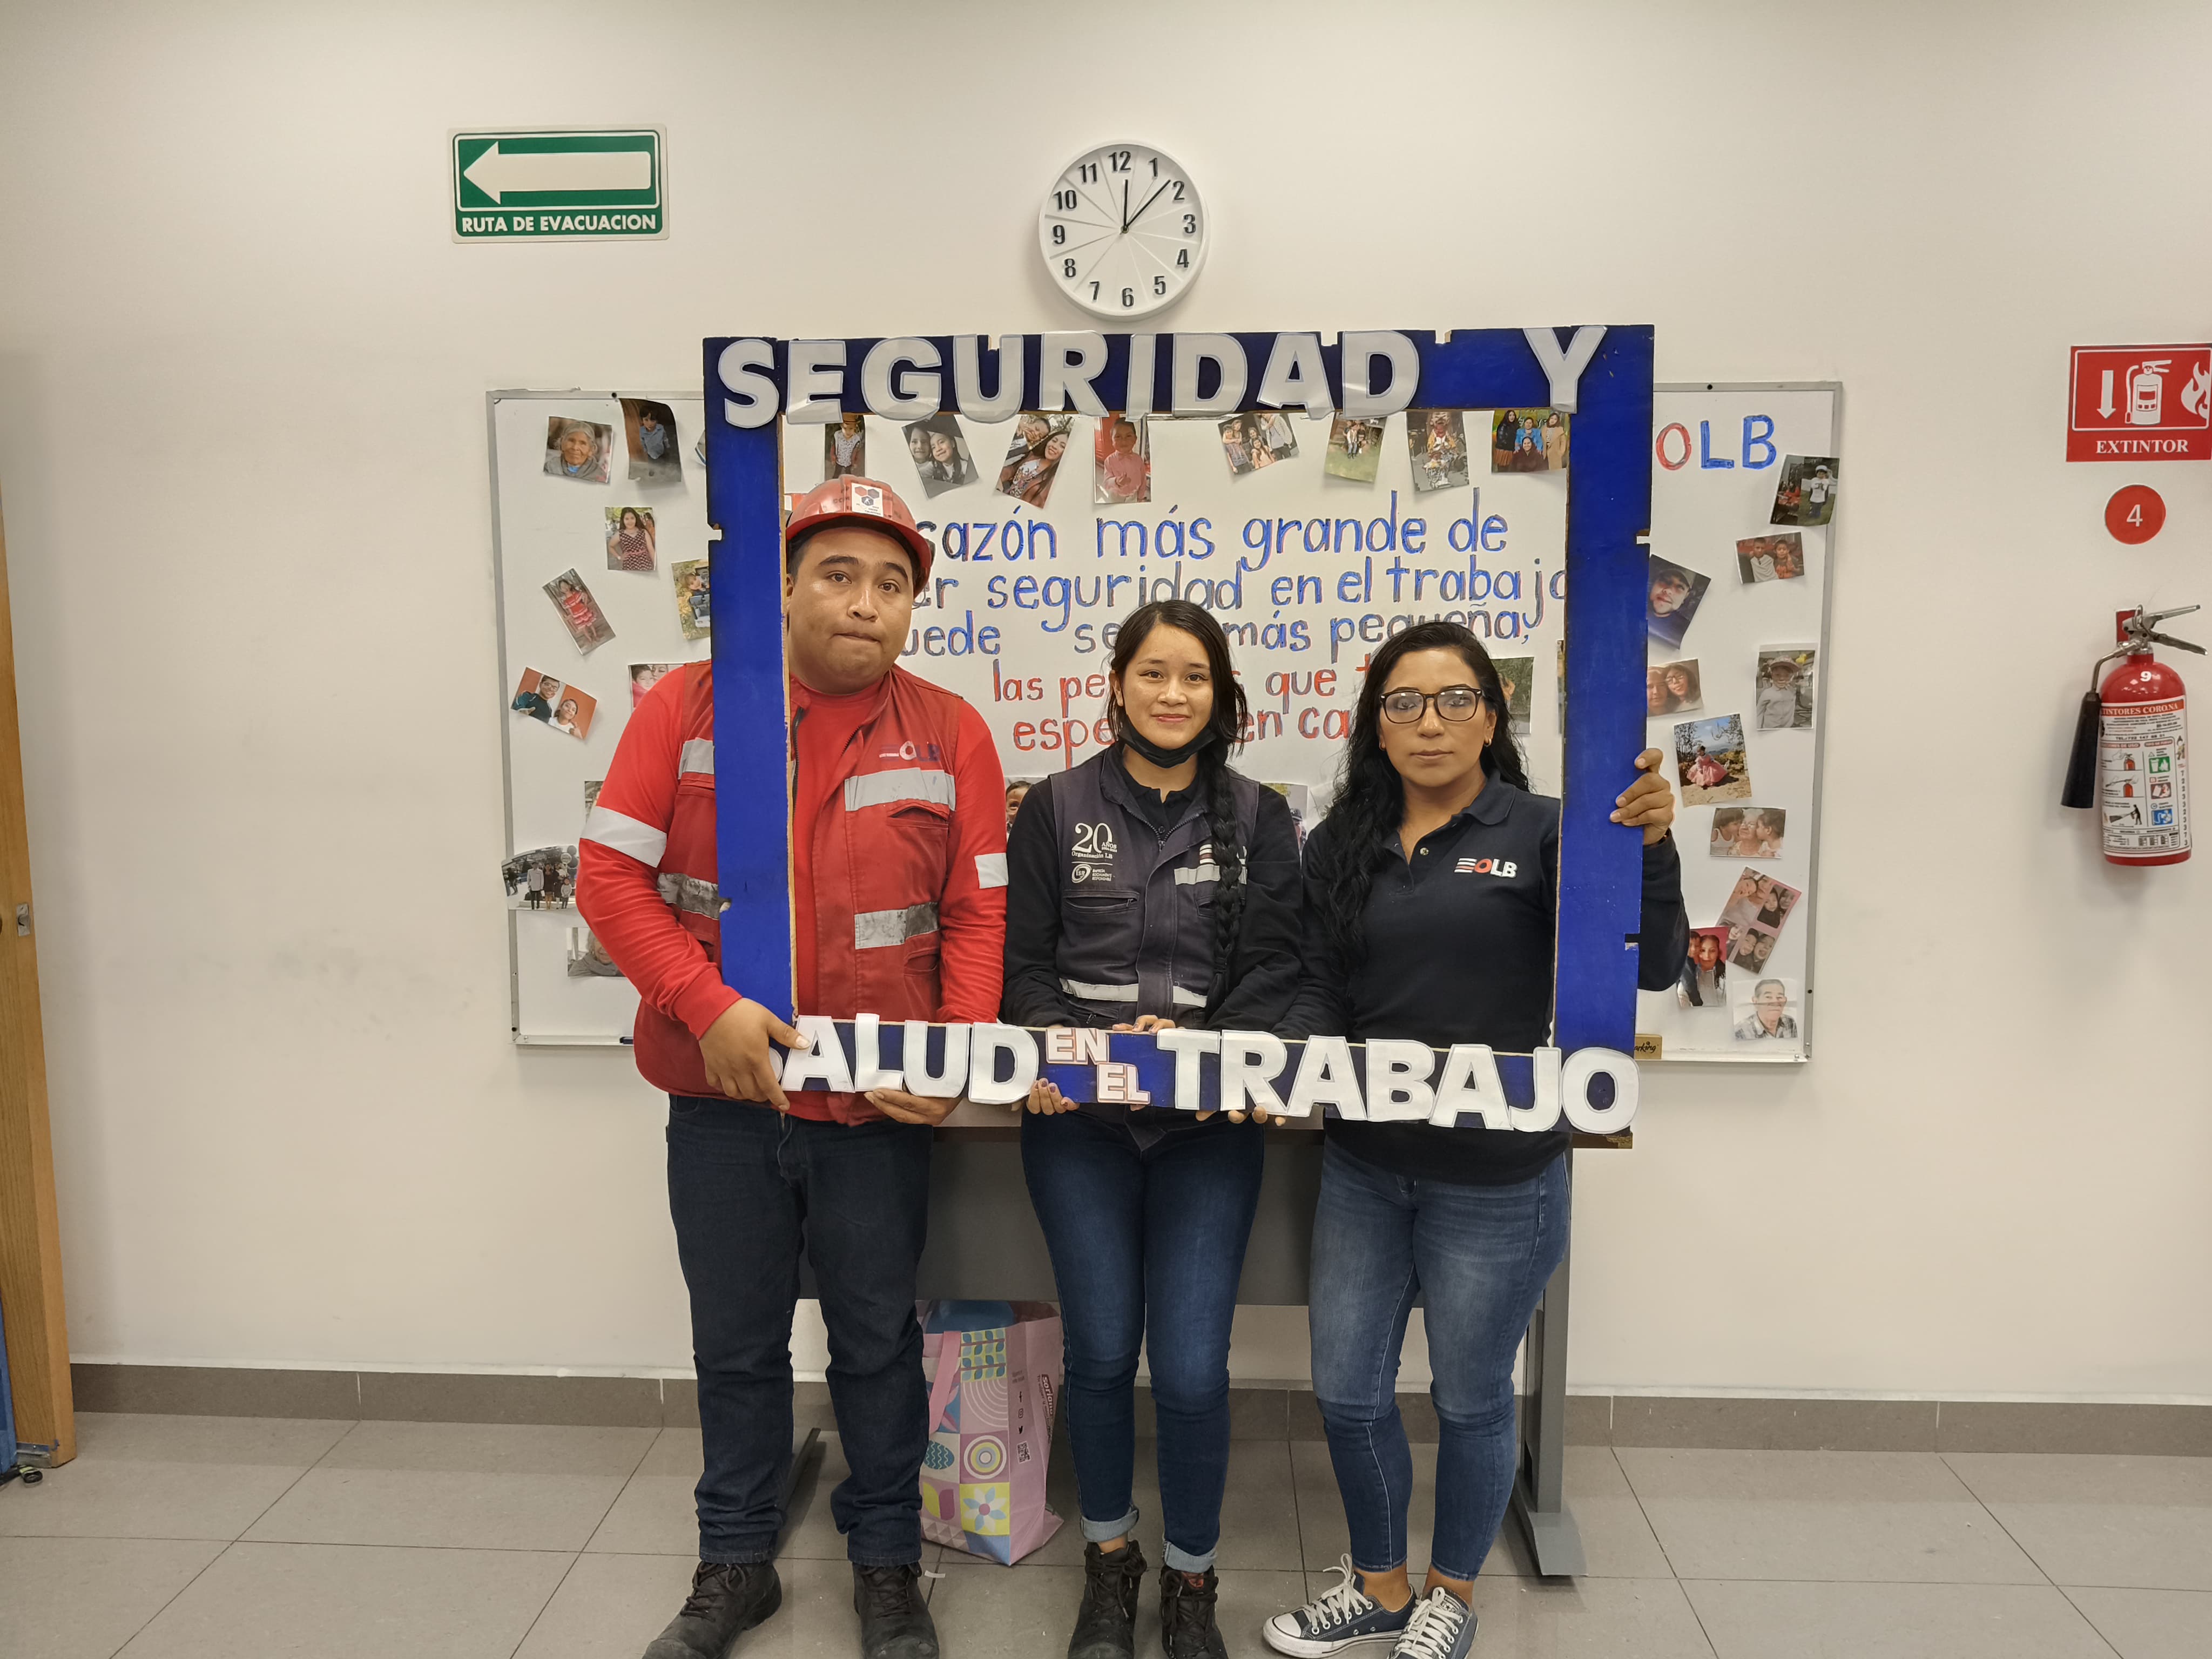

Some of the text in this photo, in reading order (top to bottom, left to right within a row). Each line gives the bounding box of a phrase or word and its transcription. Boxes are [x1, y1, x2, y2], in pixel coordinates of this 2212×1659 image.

[1108, 151, 1131, 172] 12
[1148, 158, 1158, 177] 1
[1078, 163, 1097, 183] 11
[1053, 190, 1077, 210] 10
[1172, 181, 1185, 200] 2
[462, 214, 656, 232] RUTA DE EVACUACION
[1183, 214, 1196, 233] 3
[1052, 225, 1065, 244] 9
[1064, 258, 1076, 278] 8
[1177, 249, 1189, 268] 4
[1089, 281, 1100, 300] 7
[1154, 275, 1166, 295] 5
[1122, 288, 1134, 307] 6
[718, 325, 1608, 428] SEGURIDAD Y
[1655, 414, 1777, 471] OLB
[2096, 440, 2189, 454] EXTINTOR
[2126, 504, 2143, 527] 4
[1096, 505, 1215, 559] más
[1242, 490, 1427, 572] grande
[1448, 487, 1508, 552] de
[988, 560, 1243, 632] seguridad
[1271, 574, 1323, 605] en
[1337, 556, 1372, 604] el
[900, 610, 1001, 656] uede
[1223, 610, 1311, 651] más
[1330, 602, 1529, 664] peeña,
[993, 659, 1043, 702] las
[1265, 669, 1337, 714] que
[2140, 671, 2152, 682] 9
[2102, 703, 2179, 716] TINTORES CORONA
[1071, 822, 1112, 853] 20
[1634, 1041, 1657, 1054] arking
[771, 1013, 1640, 1134] ALUD EN EL TRABAJO
